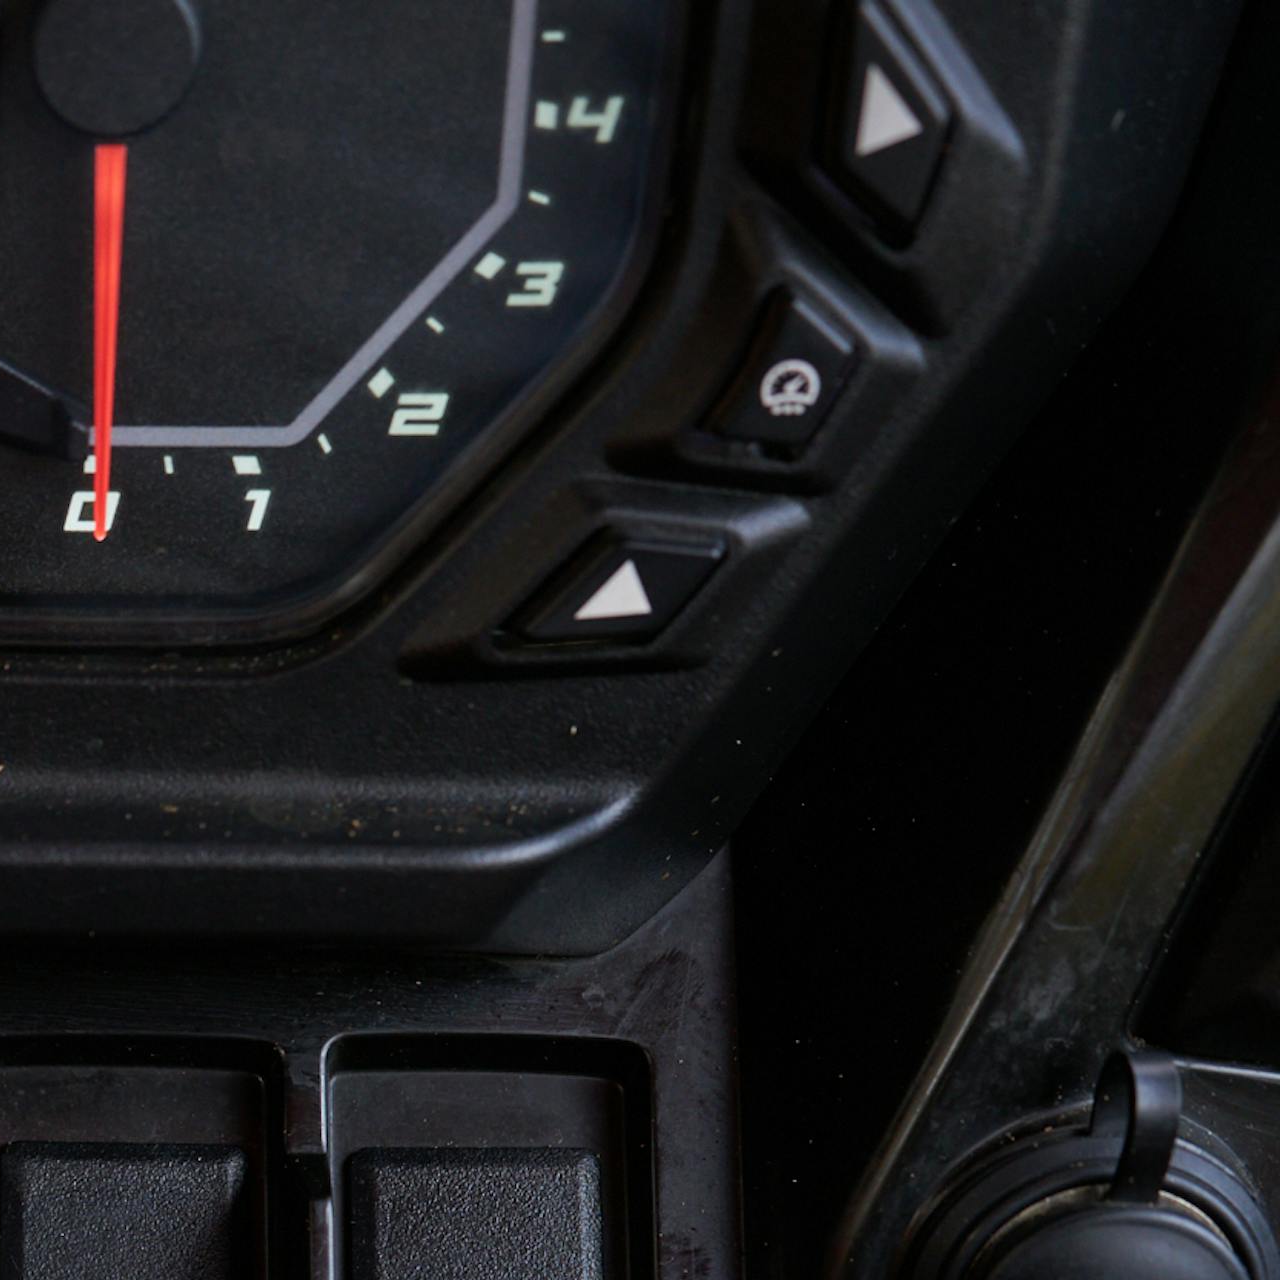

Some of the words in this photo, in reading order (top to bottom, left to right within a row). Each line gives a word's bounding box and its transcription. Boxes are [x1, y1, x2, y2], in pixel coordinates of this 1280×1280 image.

[567, 97, 624, 143] 4
[506, 261, 565, 306] 3
[388, 393, 449, 436] 2
[63, 491, 120, 532] 0
[243, 490, 271, 531] 1
